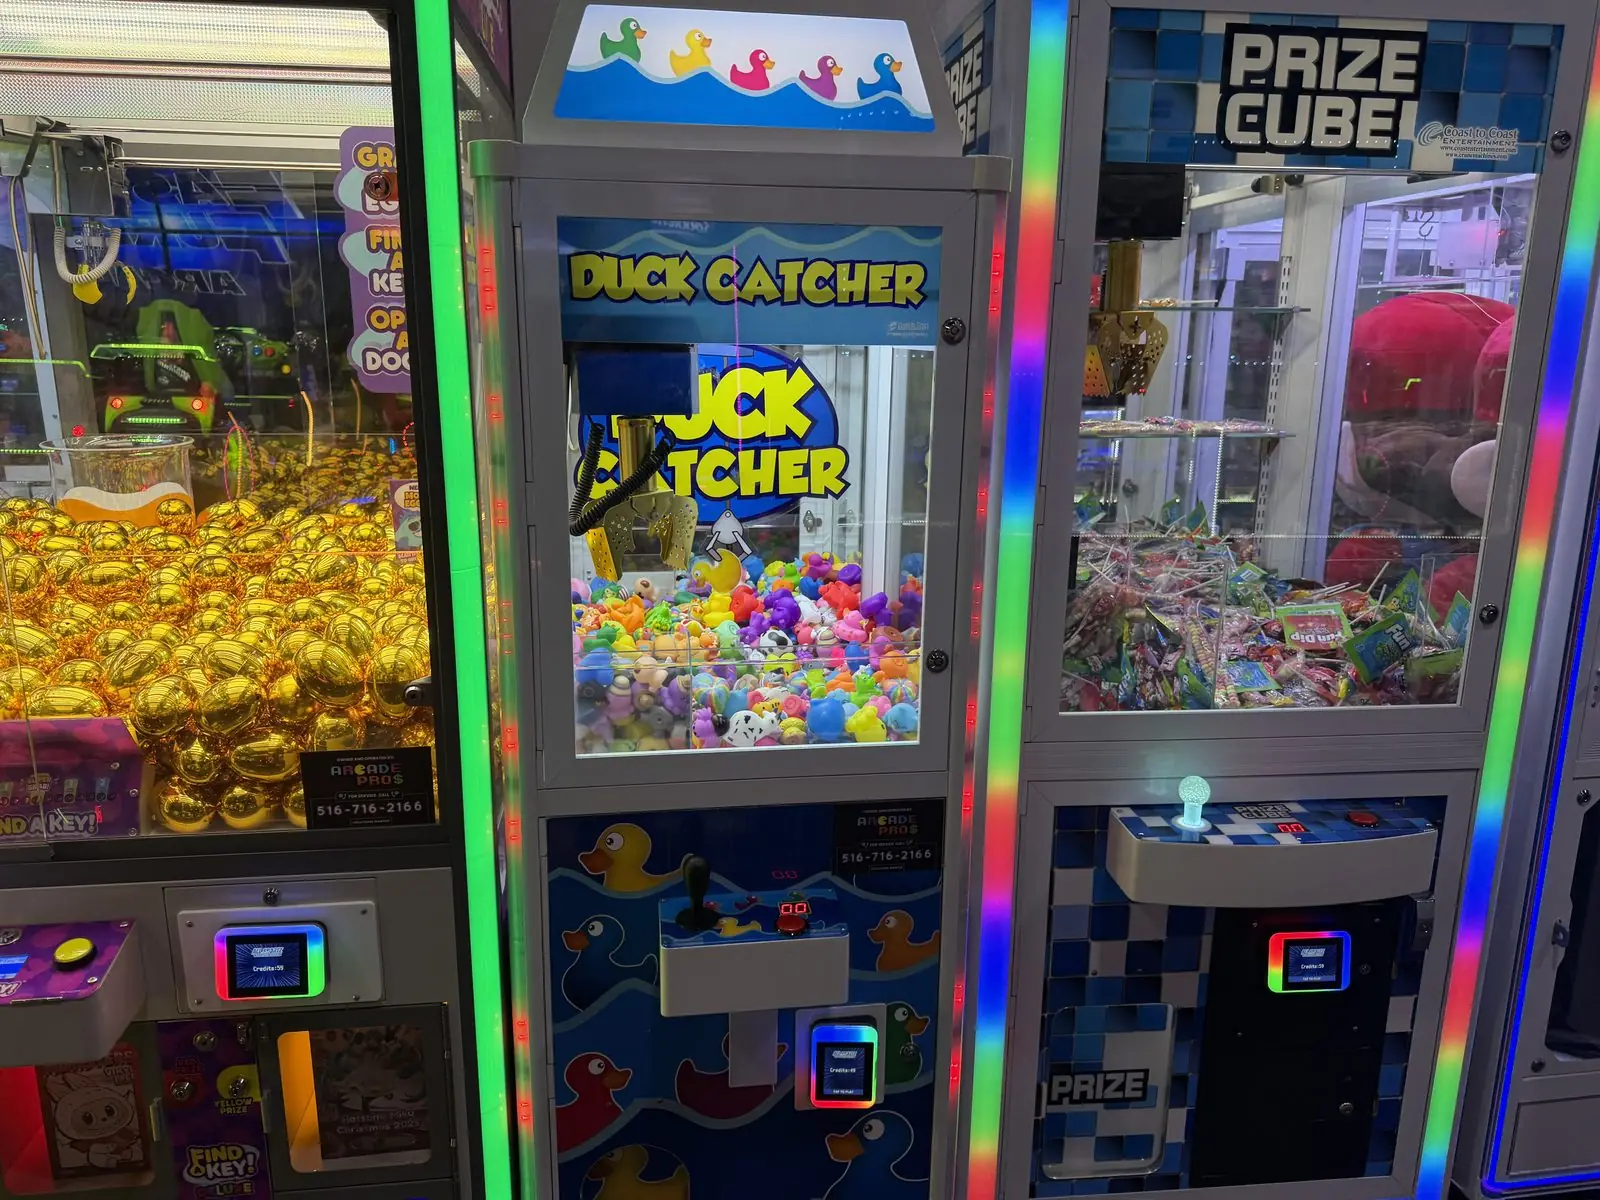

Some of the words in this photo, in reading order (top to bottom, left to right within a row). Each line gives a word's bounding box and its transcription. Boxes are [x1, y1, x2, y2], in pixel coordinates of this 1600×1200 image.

[1229, 32, 1421, 94] PRIZE
[1224, 92, 1397, 150] CUBE
[1442, 137, 1517, 147] ENTERTAINMENT
[1443, 124, 1473, 138] Coast
[1476, 128, 1486, 138] to
[1488, 127, 1518, 140] Coast
[357, 146, 398, 168] GR
[372, 272, 404, 293] KE
[568, 250, 700, 303] DUCK
[702, 254, 929, 309] CATCHER
[370, 309, 407, 331] OP
[612, 364, 816, 442] UCK
[580, 446, 851, 499] CTCHER
[1290, 631, 1317, 644] Dip
[330, 763, 401, 776] ARCADE
[316, 801, 423, 816] 516-716-2166
[48, 812, 96, 833] KEY!
[841, 849, 932, 863] 516-716-2166
[781, 902, 807, 915] 00
[1050, 1071, 1145, 1102] PRIZE
[214, 1098, 253, 1108] YELLOW
[220, 1106, 249, 1115] PRIZE
[189, 1145, 244, 1167] FIND
[206, 1152, 256, 1179] KEY!
